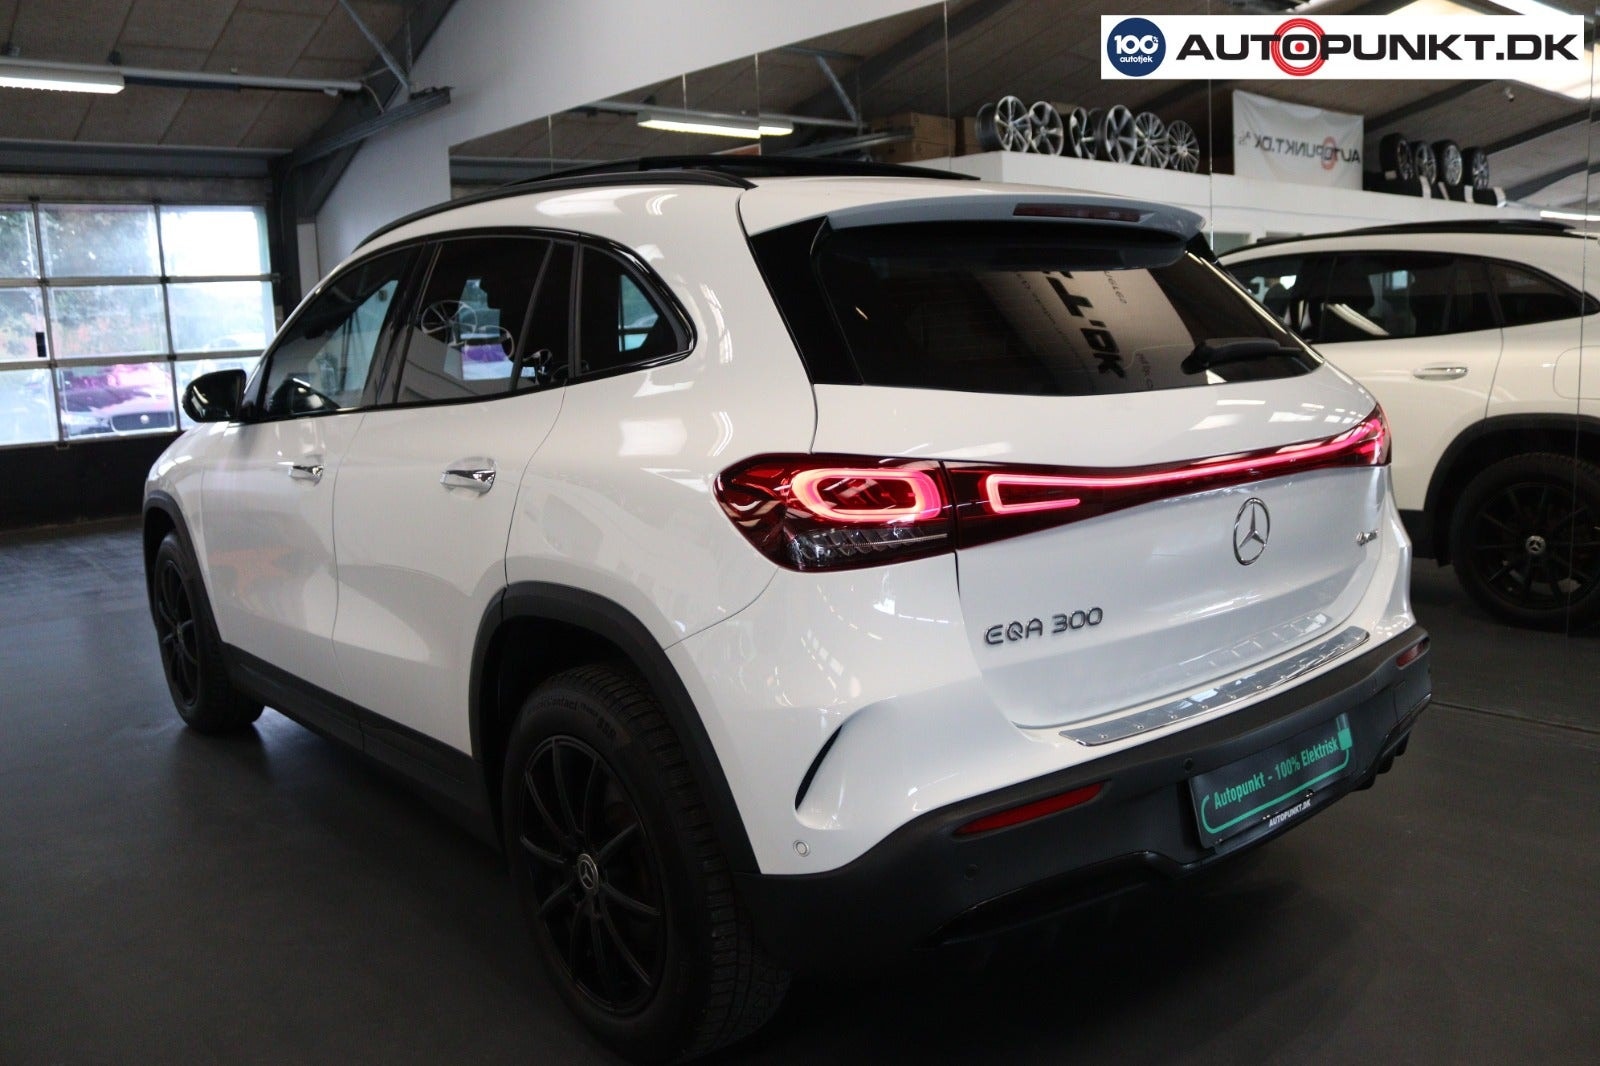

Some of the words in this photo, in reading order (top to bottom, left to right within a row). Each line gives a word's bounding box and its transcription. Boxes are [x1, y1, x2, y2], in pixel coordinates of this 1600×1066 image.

[985, 617, 1043, 645] EQA
[1052, 606, 1104, 634] 300
[1213, 771, 1266, 809] Autopunkt
[1274, 755, 1301, 781] 100%
[1301, 738, 1338, 765] Elektrisk
[1268, 799, 1312, 828] AUTOPUNKT.DK
